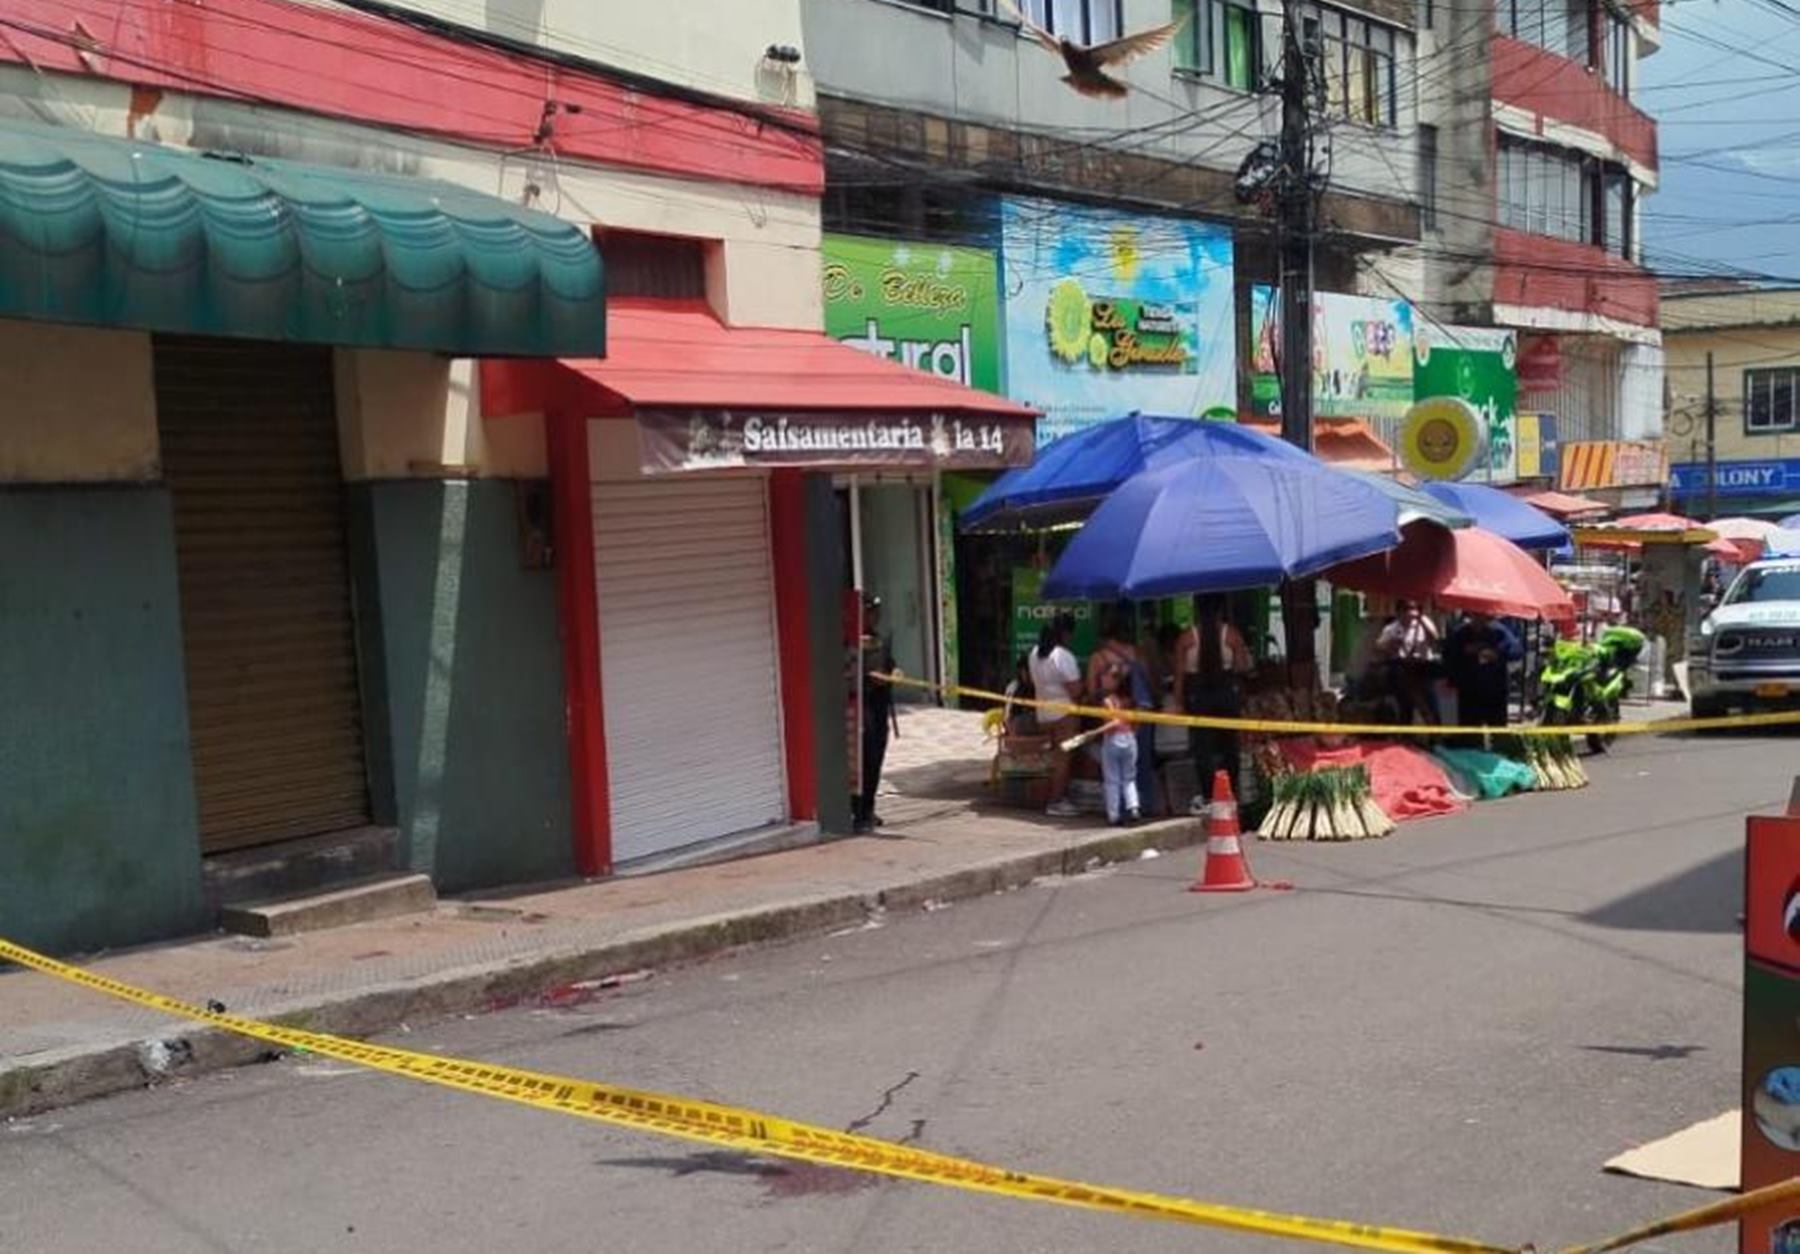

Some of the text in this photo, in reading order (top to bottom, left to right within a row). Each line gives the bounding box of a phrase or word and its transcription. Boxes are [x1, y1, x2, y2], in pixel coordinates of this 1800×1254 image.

[882, 267, 967, 319] Belleza
[743, 415, 924, 451] Salsamentaria
[1716, 467, 1775, 487] LONY
